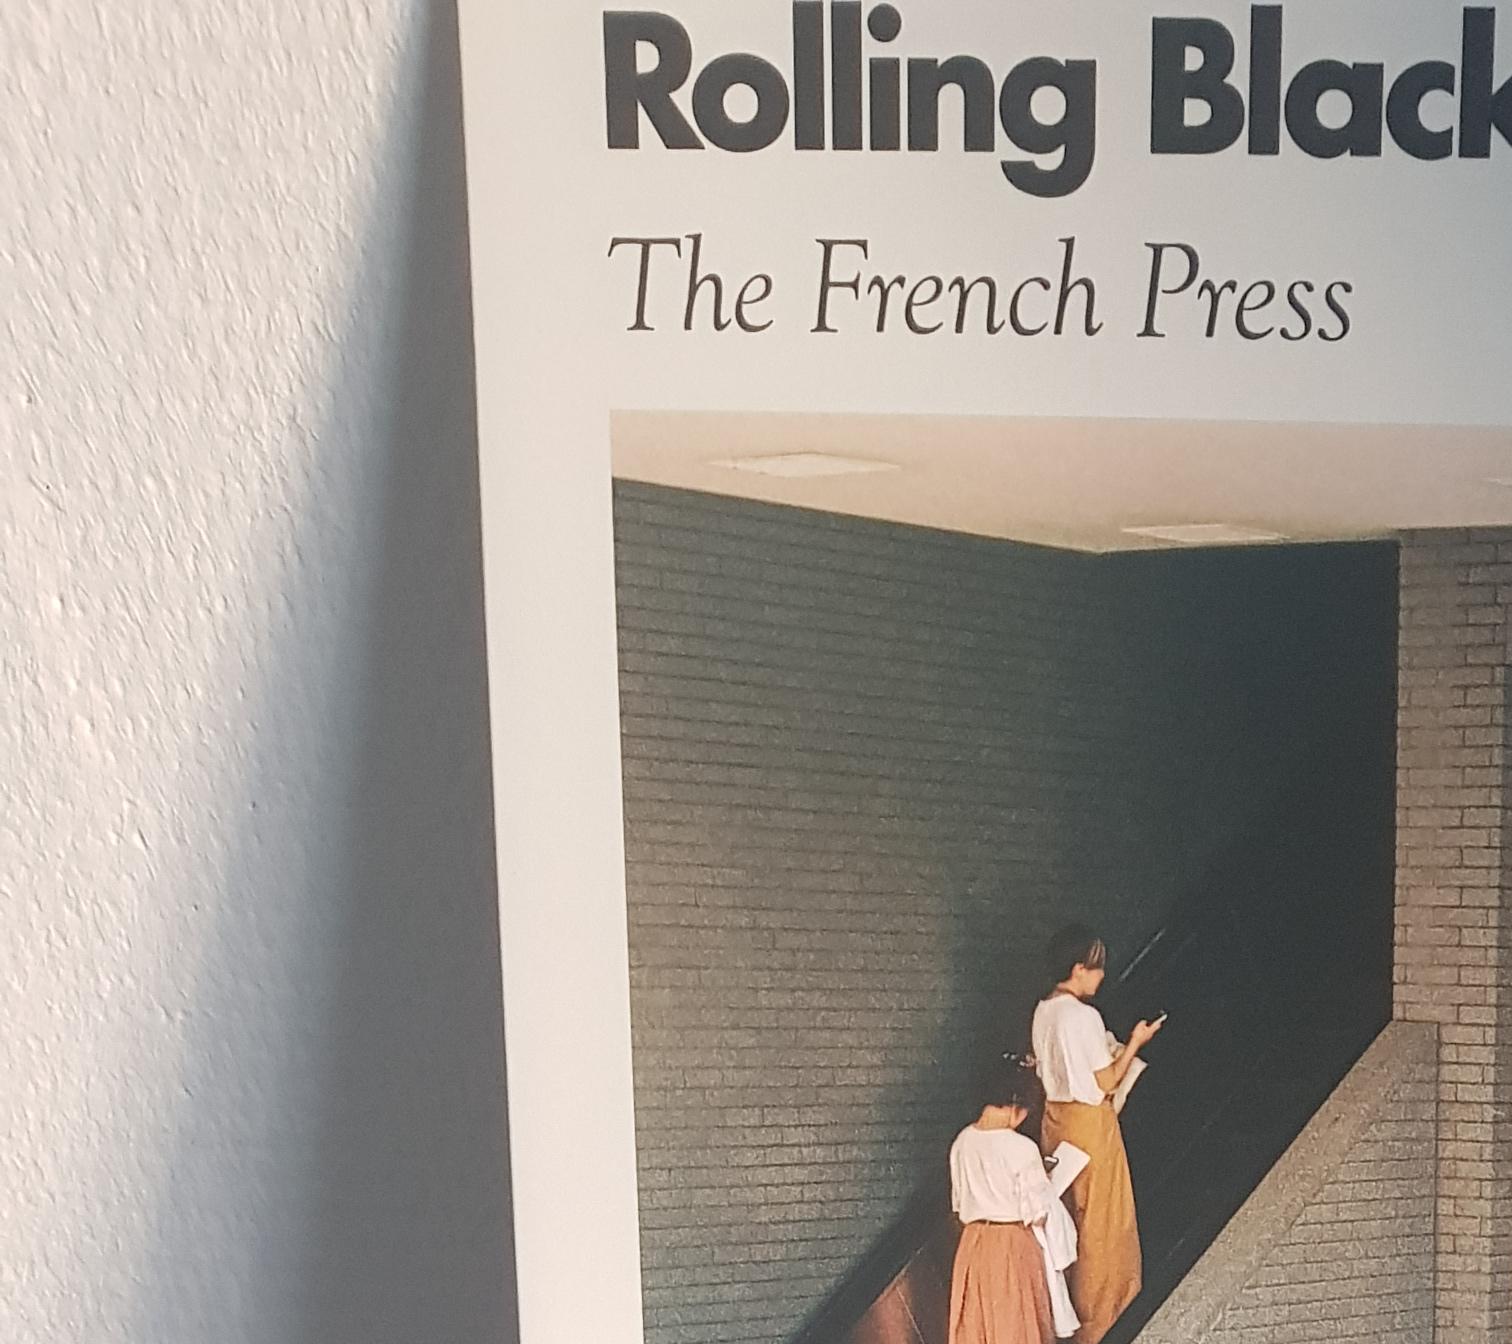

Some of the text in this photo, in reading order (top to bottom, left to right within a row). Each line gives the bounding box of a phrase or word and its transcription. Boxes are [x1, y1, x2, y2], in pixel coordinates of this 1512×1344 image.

[603, 0, 1096, 198] Rolling
[608, 233, 1352, 341] The French Press
